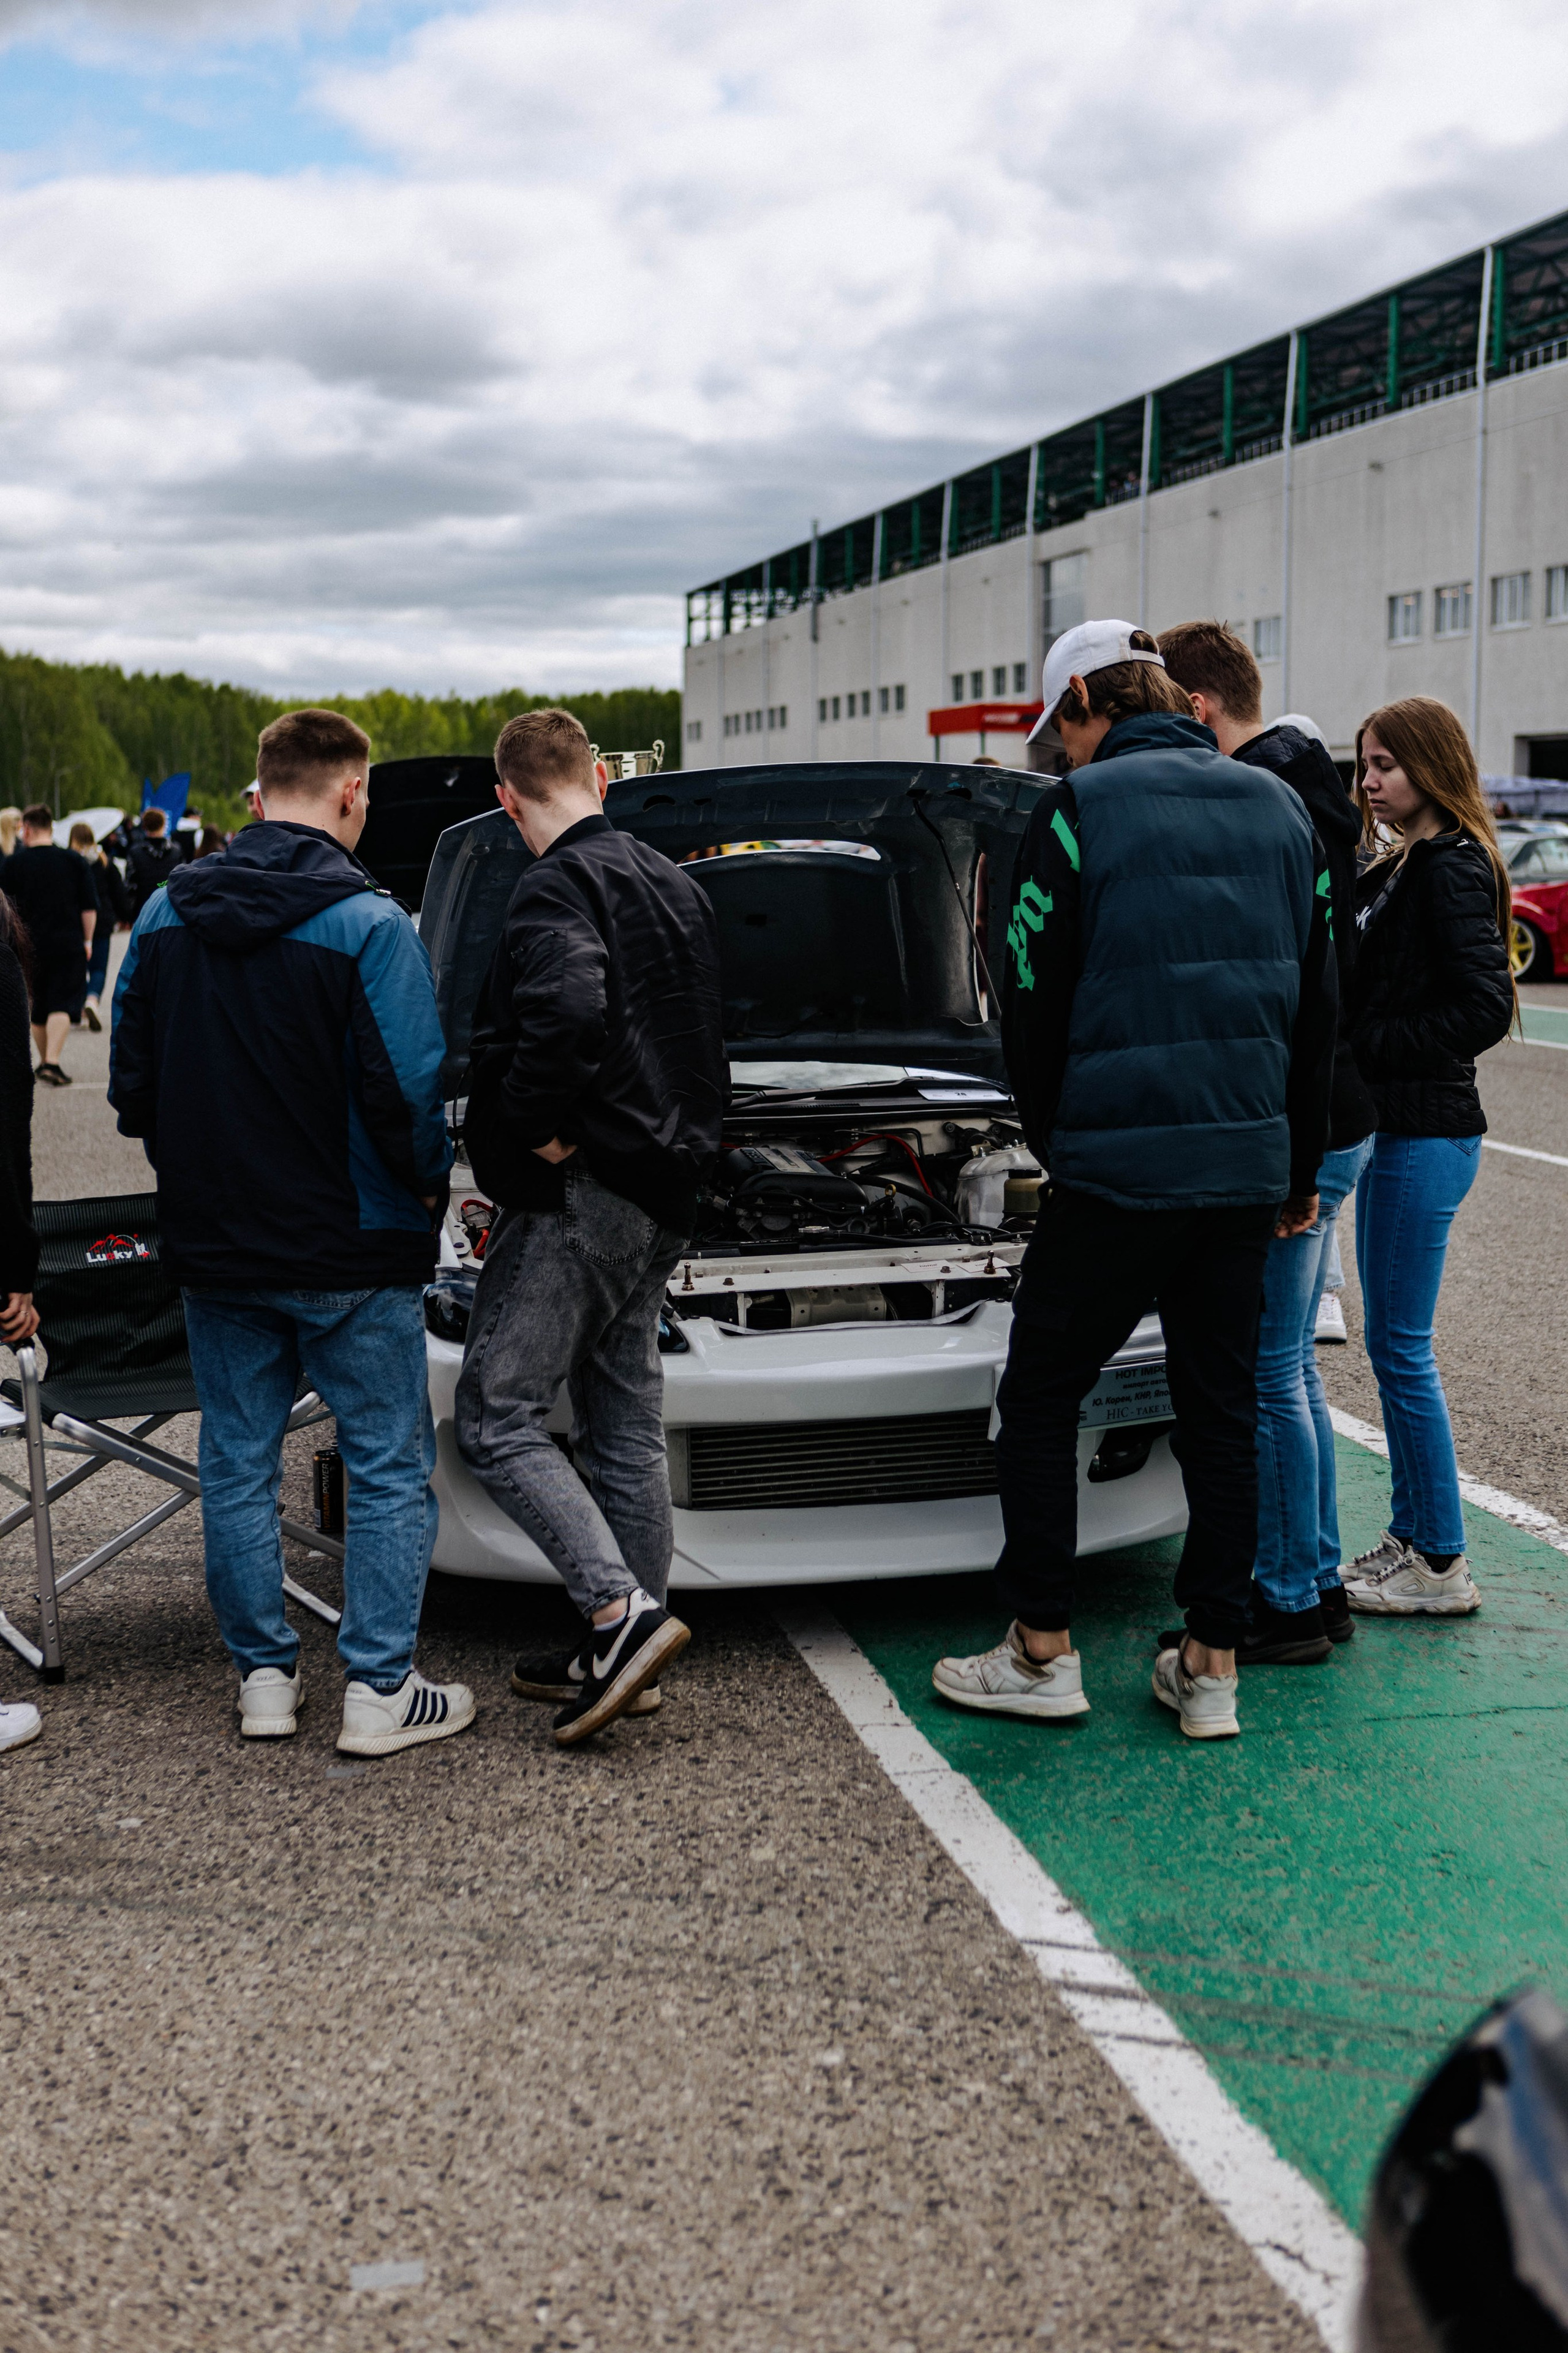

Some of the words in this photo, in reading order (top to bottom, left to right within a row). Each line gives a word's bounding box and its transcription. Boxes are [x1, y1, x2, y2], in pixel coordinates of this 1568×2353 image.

[1115, 1369, 1137, 1380] HOT
[1123, 1380, 1148, 1389] импорт
[1092, 1397, 1103, 1407] Ю.
[1134, 1390, 1152, 1400] КНР,
[1106, 1407, 1129, 1420] HIC
[1137, 1405, 1160, 1415] TAKE
